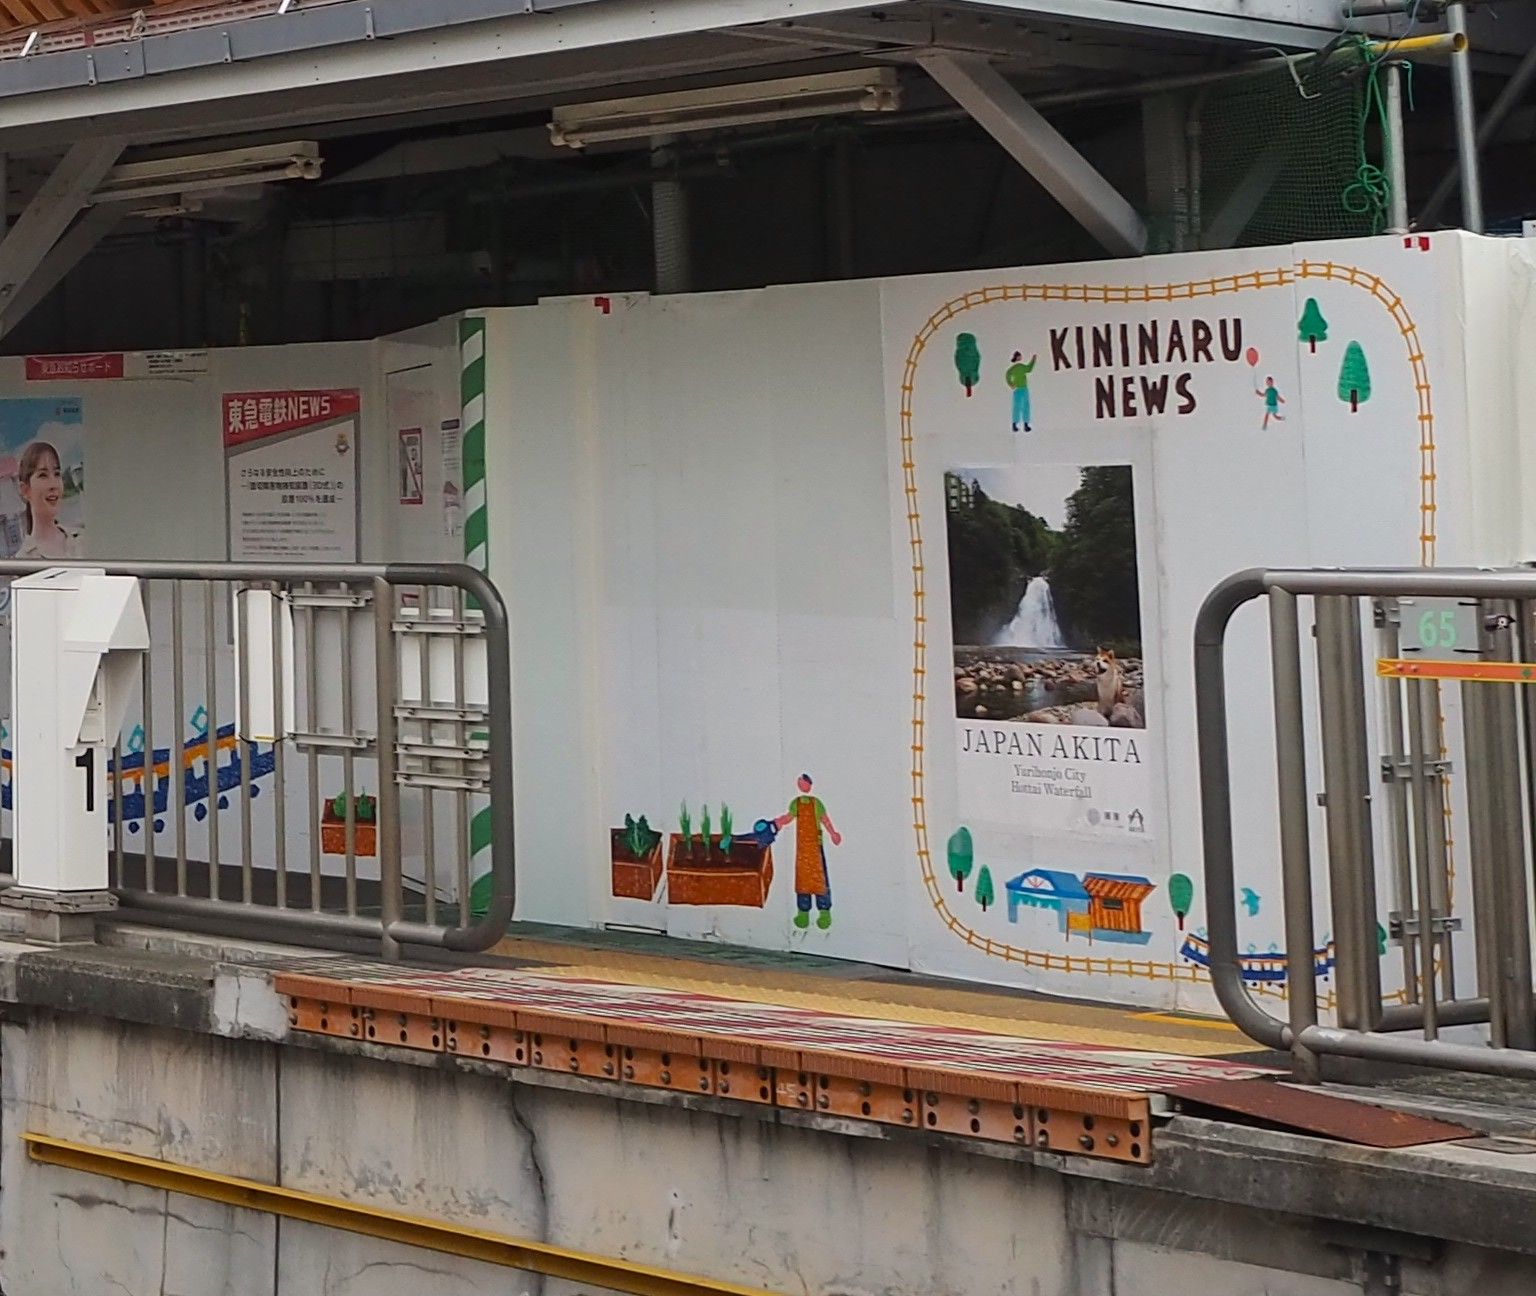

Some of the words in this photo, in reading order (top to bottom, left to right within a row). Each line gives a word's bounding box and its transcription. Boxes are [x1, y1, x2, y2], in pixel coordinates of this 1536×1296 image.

[1049, 318, 1242, 371] KININARU
[1095, 372, 1197, 419] NEWS
[228, 396, 331, 433] 東急電鉄NEWS
[1418, 611, 1458, 648] 65
[962, 728, 1043, 757] JAPAN
[1051, 734, 1142, 764] AKITA
[75, 747, 94, 812] 1
[1043, 783, 1092, 799] Waterfall
[1064, 767, 1087, 783] City
